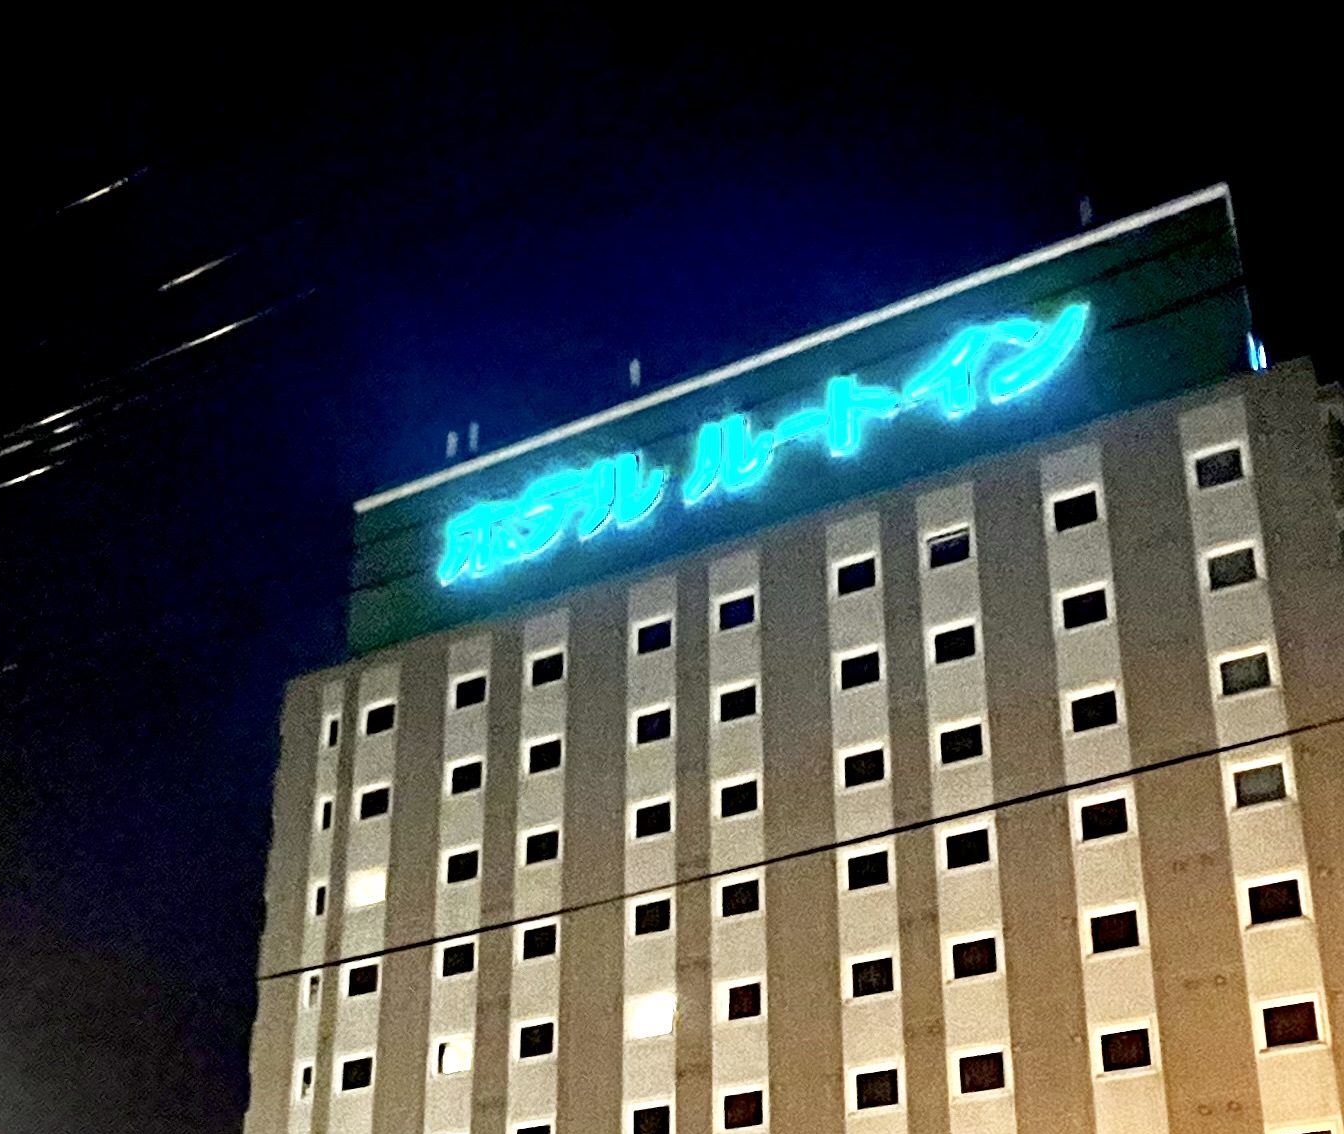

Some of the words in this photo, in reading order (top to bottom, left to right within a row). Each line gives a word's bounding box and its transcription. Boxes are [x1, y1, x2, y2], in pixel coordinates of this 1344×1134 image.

[439, 452, 666, 585] ホテル
[682, 302, 1090, 506] ルートイン
